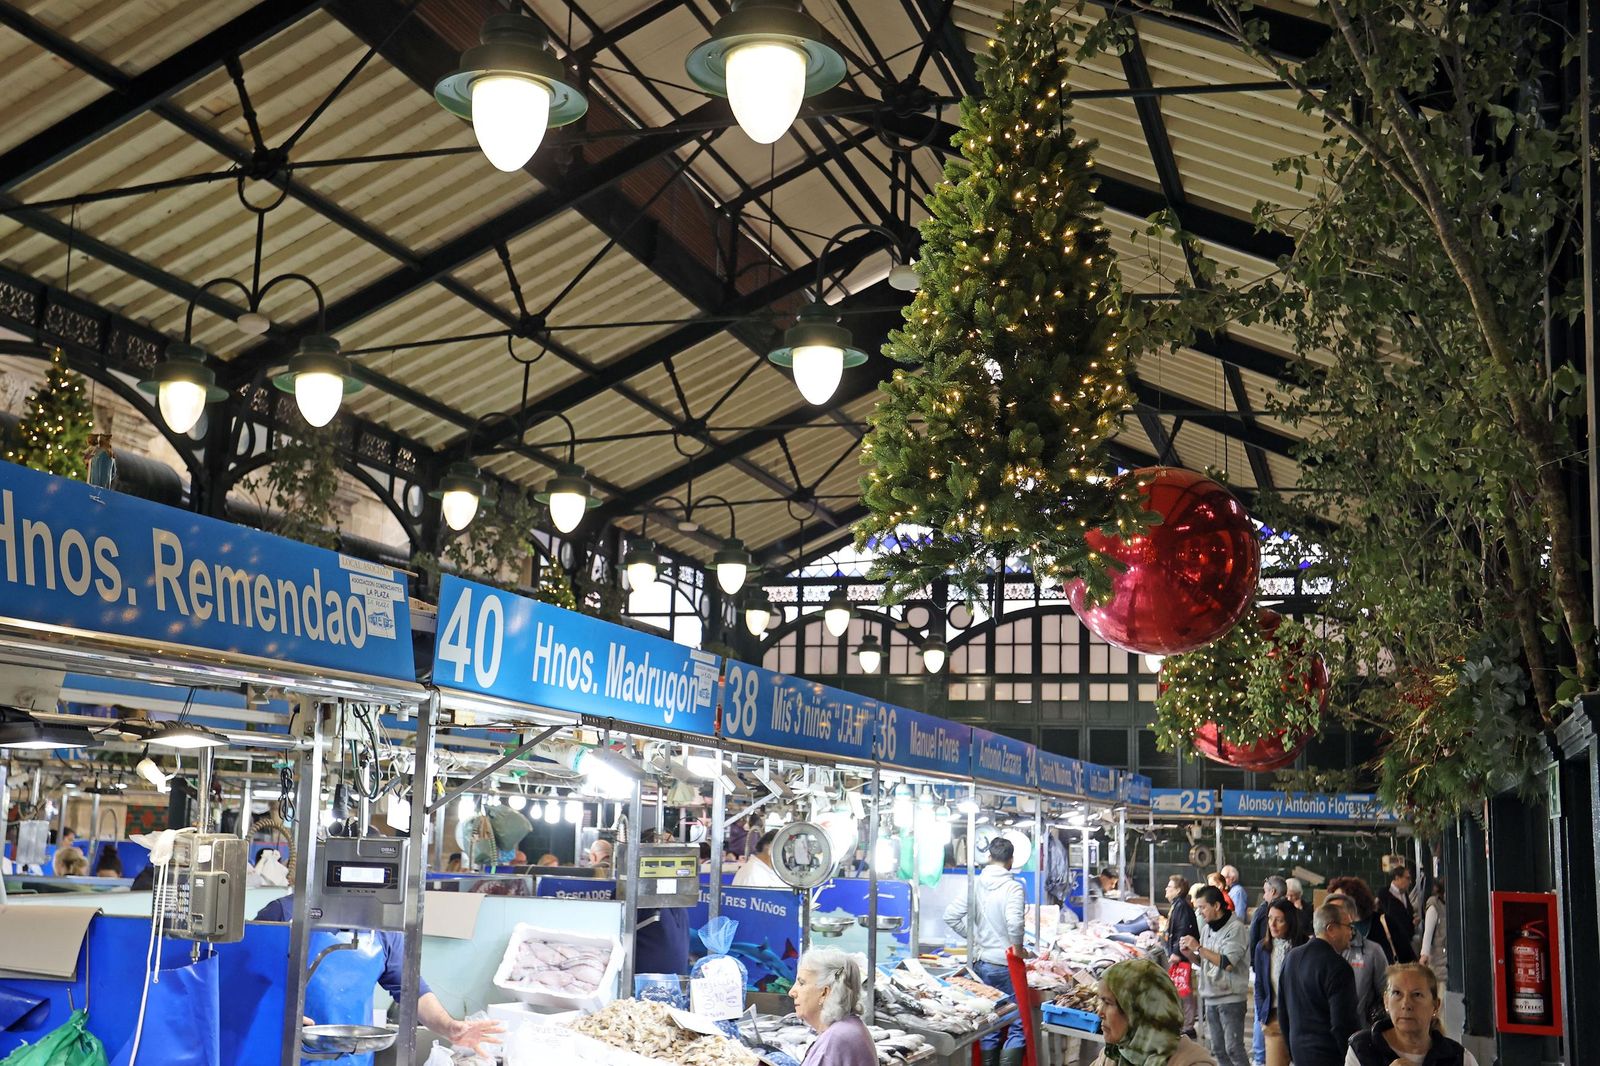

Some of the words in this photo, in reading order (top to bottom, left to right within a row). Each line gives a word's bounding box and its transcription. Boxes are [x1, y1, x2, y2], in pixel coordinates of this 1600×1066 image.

[341, 557, 363, 570] LOCAL
[152, 527, 368, 649] Remendao
[366, 588, 373, 596] LA
[374, 590, 390, 599] PLAZA
[438, 587, 504, 689] 40
[532, 622, 598, 695] Hnos.
[604, 642, 699, 724] Madrugón
[725, 665, 759, 737] 38
[771, 686, 792, 733] Mis
[794, 692, 802, 735] 3
[877, 706, 897, 761] 36
[910, 721, 937, 760] Manuel
[938, 727, 960, 763] Flores
[1180, 790, 1211, 813] 25
[1238, 795, 1274, 812] Alonso
[1275, 799, 1283, 815] y
[1285, 796, 1326, 814] Antonio
[697, 889, 711, 904] IS
[720, 892, 747, 909] TRES
[750, 897, 787, 917] NIÑOS
